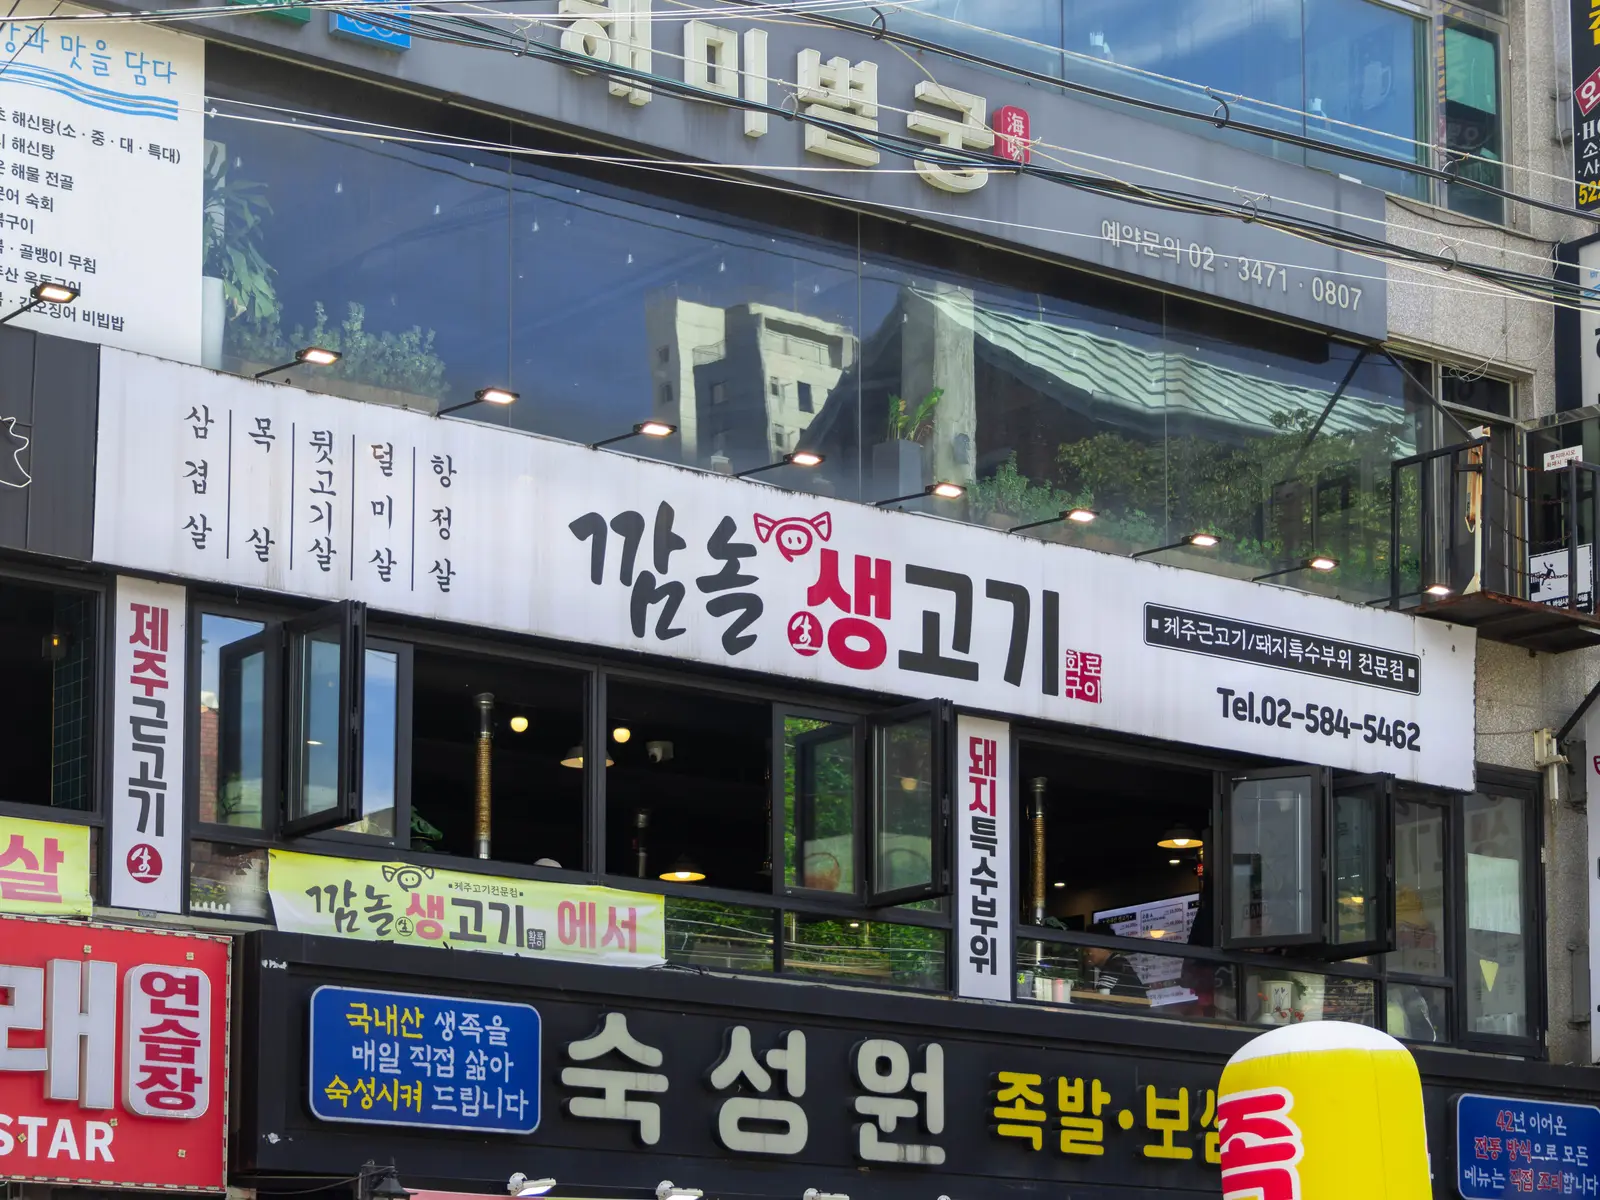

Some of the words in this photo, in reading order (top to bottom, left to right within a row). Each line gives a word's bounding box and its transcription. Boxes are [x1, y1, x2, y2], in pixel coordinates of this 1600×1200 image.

[60, 35, 112, 77] 맛을
[125, 51, 178, 86] 담다
[12, 111, 77, 139] 해신탕(소
[91, 129, 105, 147] 중
[120, 137, 134, 154] 대
[148, 143, 181, 164] 특대)
[12, 137, 55, 161] 해신탕
[11, 163, 40, 183] 해물
[45, 170, 74, 191] 전골
[25, 193, 54, 213] 숙회
[20, 243, 62, 267] 골뱅이
[68, 254, 96, 274] 무침
[1101, 220, 1180, 265] 예약문의
[1188, 242, 1215, 272] 02
[1237, 257, 1288, 291] 3471
[1312, 277, 1362, 311] 0807
[82, 310, 124, 332] 비빕밥
[181, 404, 215, 551] 삼겹살
[245, 417, 275, 563] 목살
[308, 430, 337, 572] 뒷고기살
[369, 442, 397, 583] 덜미살
[428, 454, 457, 593] 항정살
[807, 548, 1060, 698] 생고기
[1163, 616, 1352, 671] 제주근고기/돼지특수부위
[1358, 652, 1404, 682] 전문점
[128, 602, 169, 838] 제주근고기
[1217, 686, 1421, 752] Tel.02-584-5462
[968, 735, 999, 976] 돼지특수부위
[454, 881, 518, 898] 제주고기전문점
[557, 899, 638, 954] 에서
[136, 970, 203, 1111] 연습장
[345, 1002, 425, 1039] 국내산
[434, 1010, 511, 1047] 생족을
[352, 1039, 402, 1075] 매일
[409, 1044, 455, 1079] 직접
[465, 1049, 514, 1083] 삶아
[324, 1075, 423, 1113] 숙성시켜
[431, 1084, 529, 1121] 드립니다
[560, 1012, 947, 1165] 숙성원
[1496, 1110, 1526, 1133] 42년
[1530, 1112, 1567, 1136] 이어온
[1474, 1135, 1502, 1160] 전통
[1506, 1138, 1558, 1163] 방식으로
[1562, 1145, 1589, 1167] 모든
[1464, 1165, 1506, 1189] 메뉴는
[1510, 1168, 1534, 1192] 직접
[1537, 1170, 1600, 1196] 조리합니다
